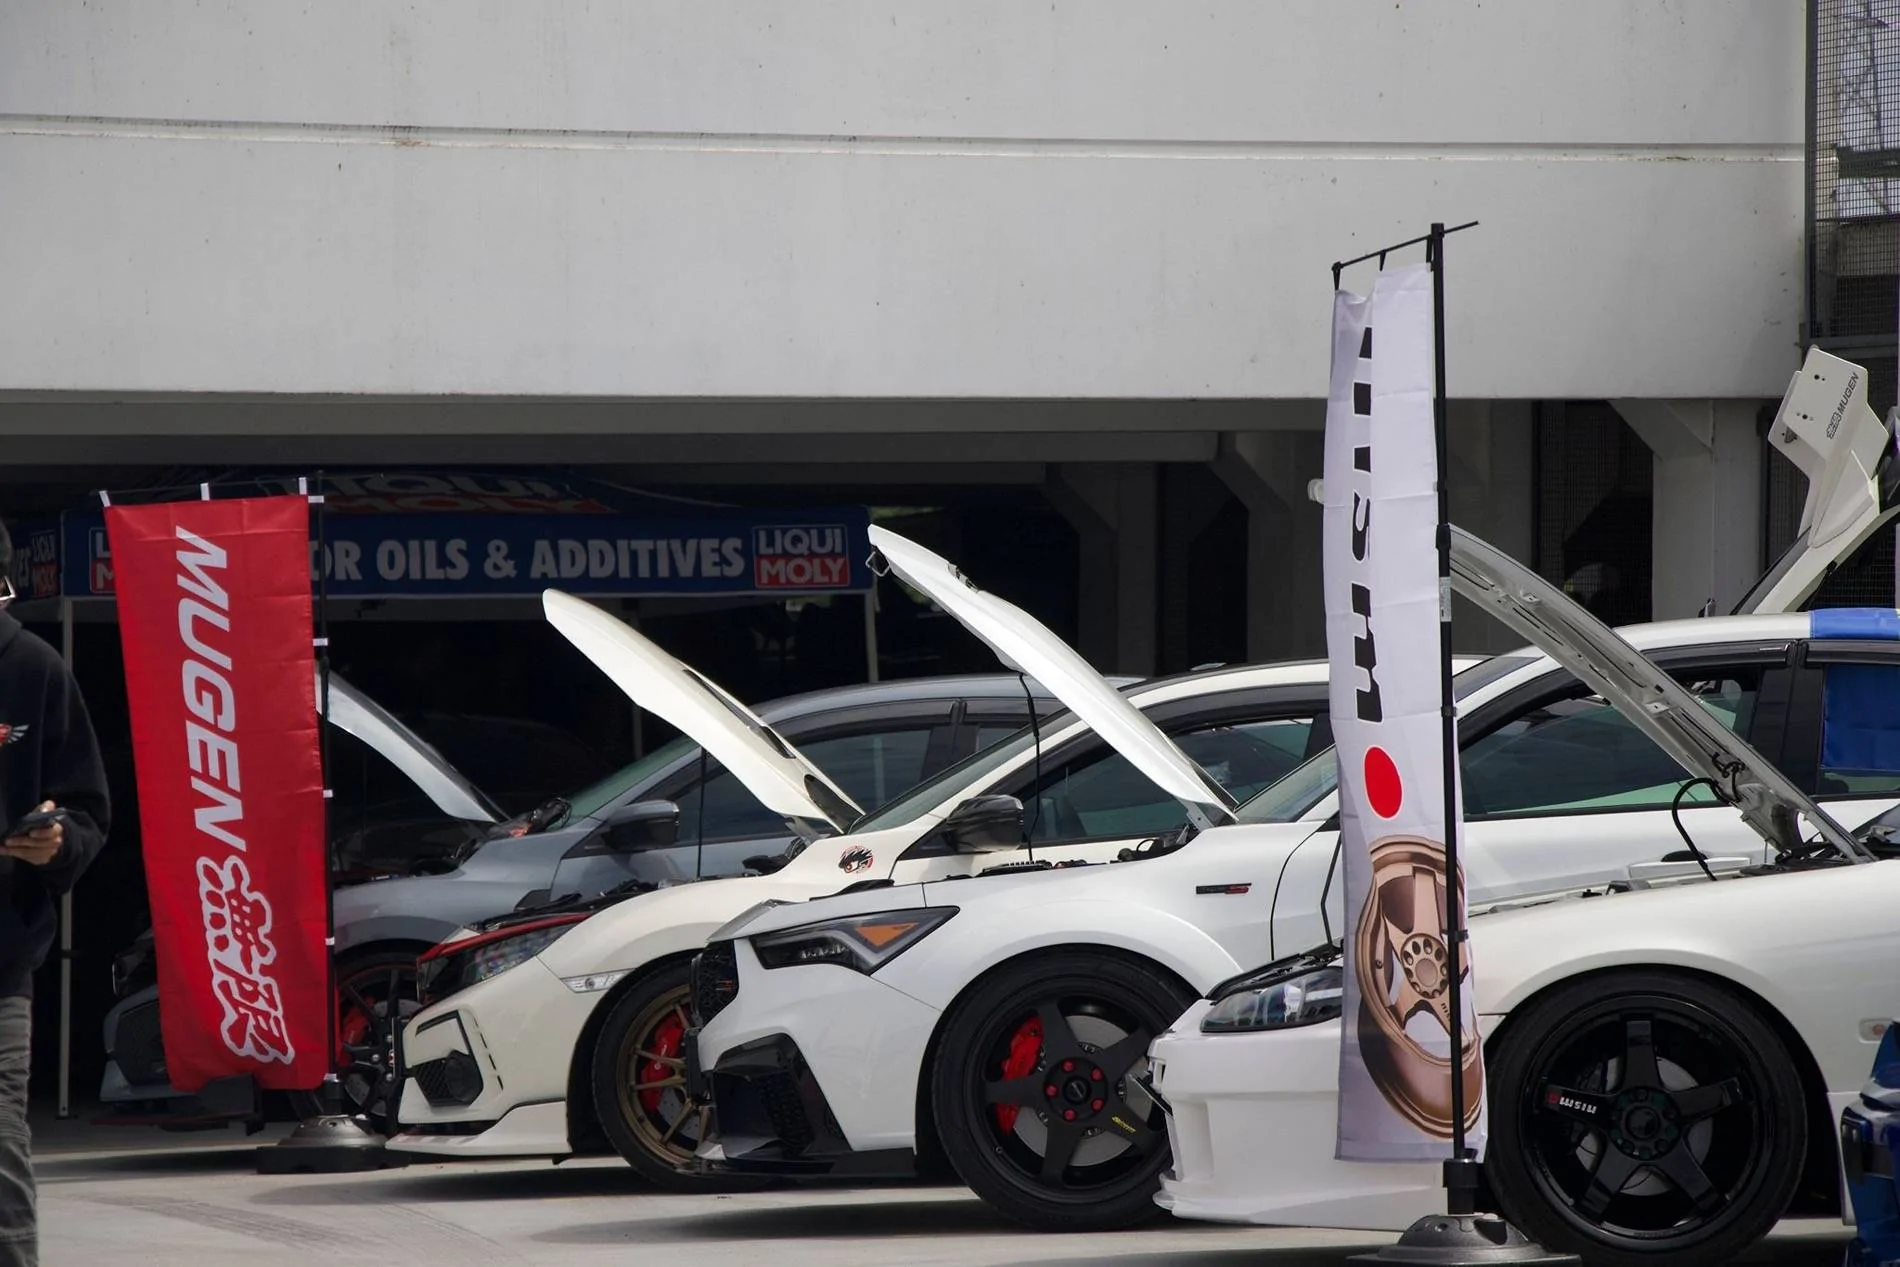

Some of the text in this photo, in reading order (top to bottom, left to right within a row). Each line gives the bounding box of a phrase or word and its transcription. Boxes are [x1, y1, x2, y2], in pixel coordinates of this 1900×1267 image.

[1837, 372, 1860, 415] MUGEN
[376, 538, 470, 581] OILS
[483, 540, 518, 579] &
[530, 537, 745, 580] ADDITIVES
[758, 528, 842, 556] LIQUI
[760, 557, 846, 584] MOLY
[174, 525, 247, 852] MUGEN
